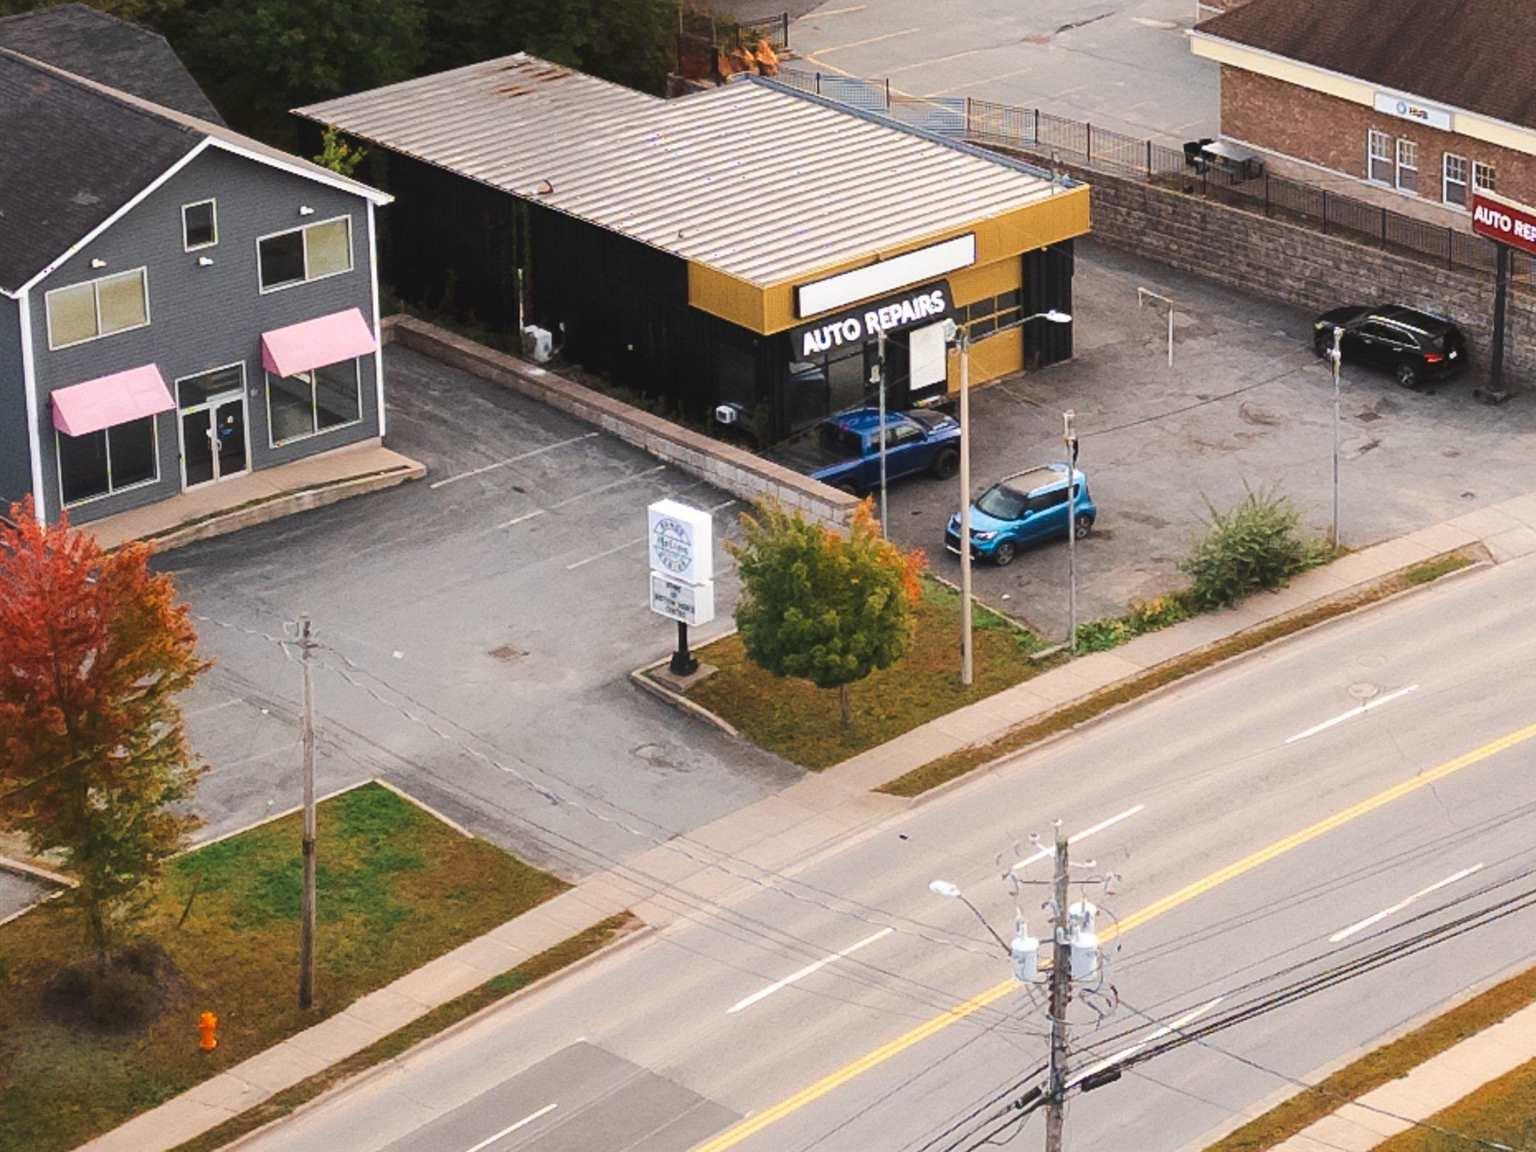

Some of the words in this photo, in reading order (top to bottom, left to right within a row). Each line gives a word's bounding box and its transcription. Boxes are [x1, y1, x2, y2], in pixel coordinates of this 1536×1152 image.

[1409, 105, 1429, 120] HUB
[1474, 205, 1512, 232] AUTO
[803, 318, 861, 356] AUTO
[865, 290, 946, 335] REPAIRS
